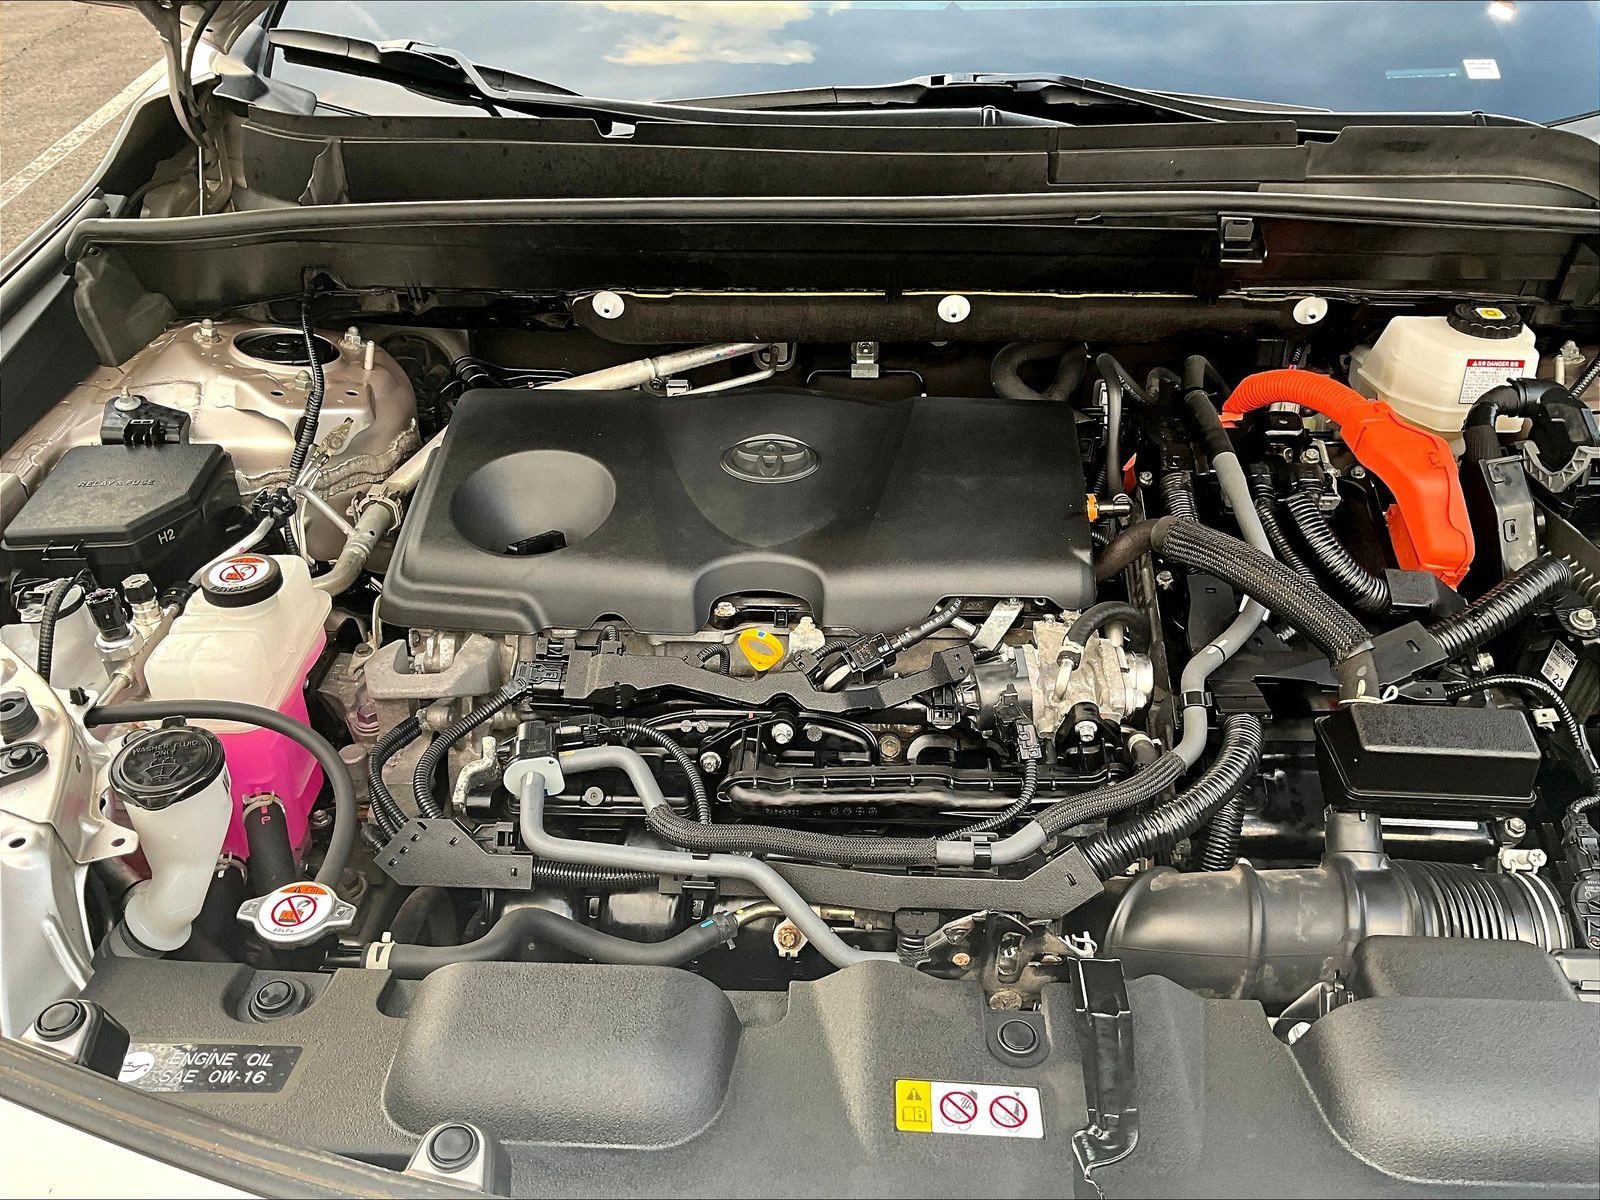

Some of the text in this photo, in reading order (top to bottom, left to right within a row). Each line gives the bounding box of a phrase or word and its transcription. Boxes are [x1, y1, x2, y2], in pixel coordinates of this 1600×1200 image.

[78, 479, 115, 488] RELAY
[158, 528, 176, 544] H2
[1552, 673, 1564, 688] 23
[133, 744, 169, 754] WASHER
[153, 748, 176, 757] ONLY
[168, 1052, 274, 1067] ENGINE OIL
[159, 1069, 267, 1084] SAE 0W-16
